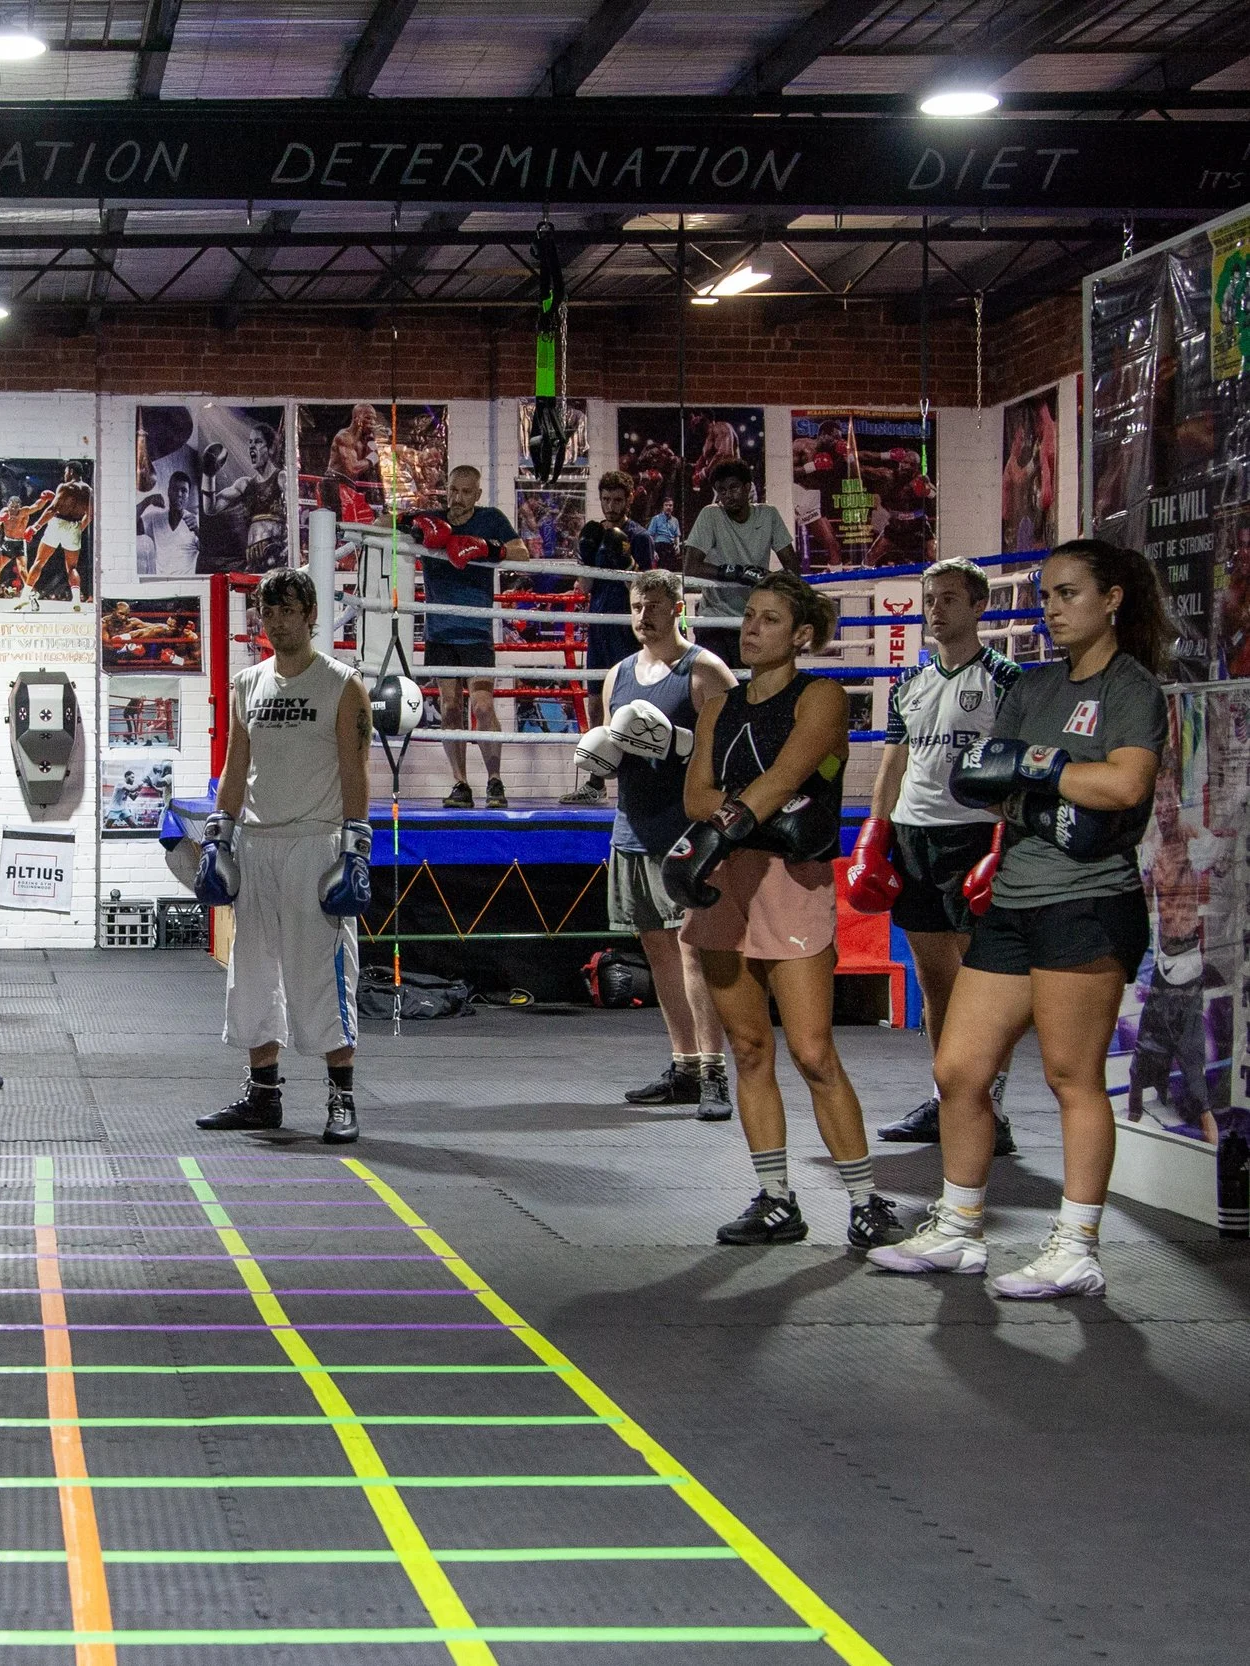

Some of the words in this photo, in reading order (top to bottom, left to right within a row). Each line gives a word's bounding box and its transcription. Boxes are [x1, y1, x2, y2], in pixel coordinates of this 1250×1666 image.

[269, 141, 803, 190] DETERMINATION
[906, 145, 1080, 191] DIET
[1150, 495, 1177, 528] THE
[1178, 488, 1209, 523] WILL
[1166, 539, 1178, 557] BE
[1167, 563, 1190, 583] THAN
[1177, 592, 1205, 617] SKILL
[253, 698, 311, 709] LUCKY
[247, 708, 318, 724] PUNCH
[6, 866, 64, 882] ALTIUS
